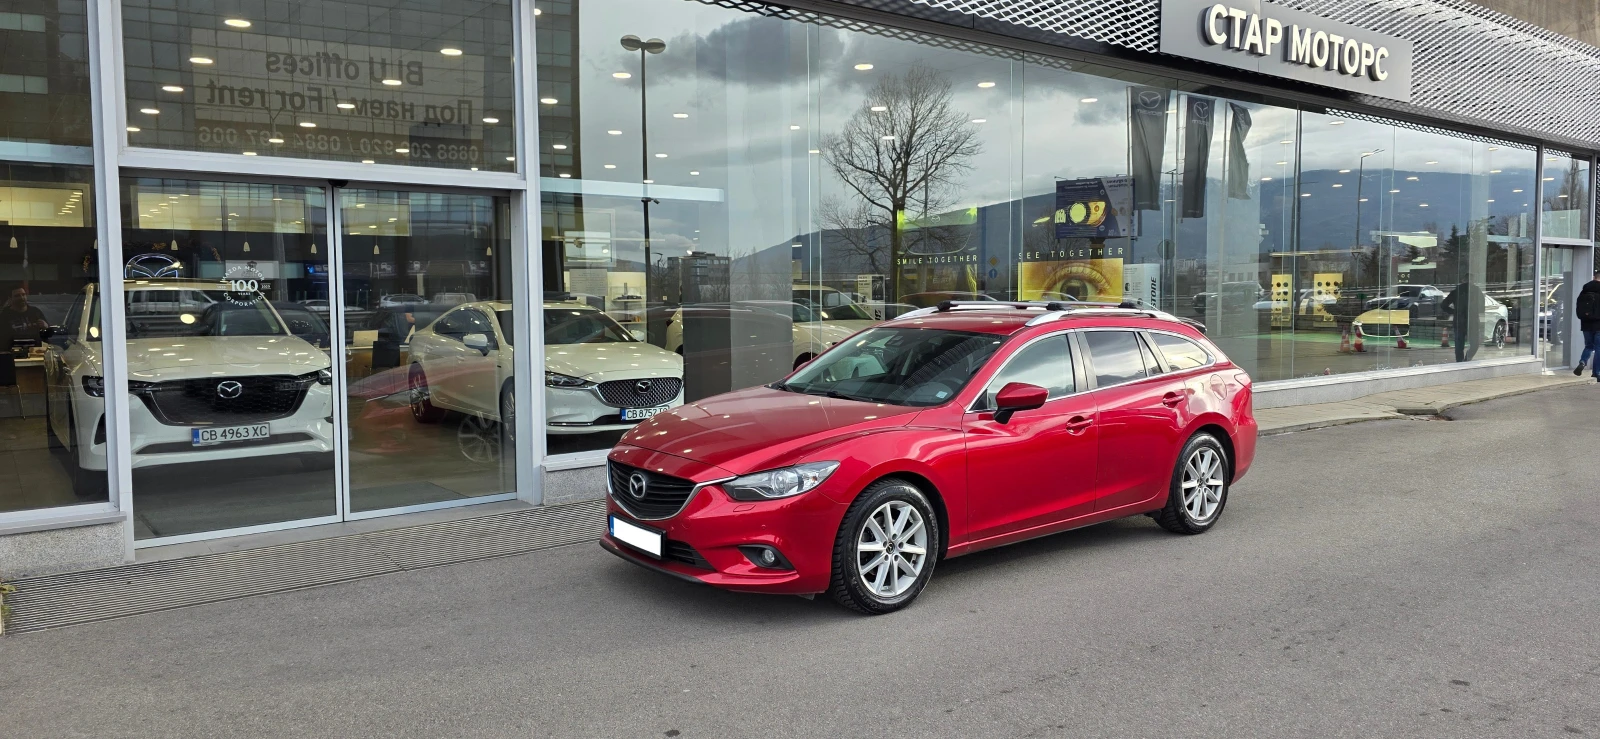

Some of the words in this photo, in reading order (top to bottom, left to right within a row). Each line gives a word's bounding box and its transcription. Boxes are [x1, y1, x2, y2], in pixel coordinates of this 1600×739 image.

[1206, 3, 1283, 56] СТАР
[1287, 24, 1390, 82] МОТОРС
[896, 257, 923, 265] SMILE
[928, 254, 977, 264] TOGETHER
[1018, 251, 1040, 260] SEE
[1050, 247, 1124, 258] TOGETHER
[221, 265, 242, 281] MAZDA
[244, 265, 265, 282] MOTOR
[229, 279, 258, 292] 100
[627, 409, 638, 419] CB
[201, 429, 218, 441] CB
[220, 427, 250, 440] 4963
[252, 425, 268, 438] XC
